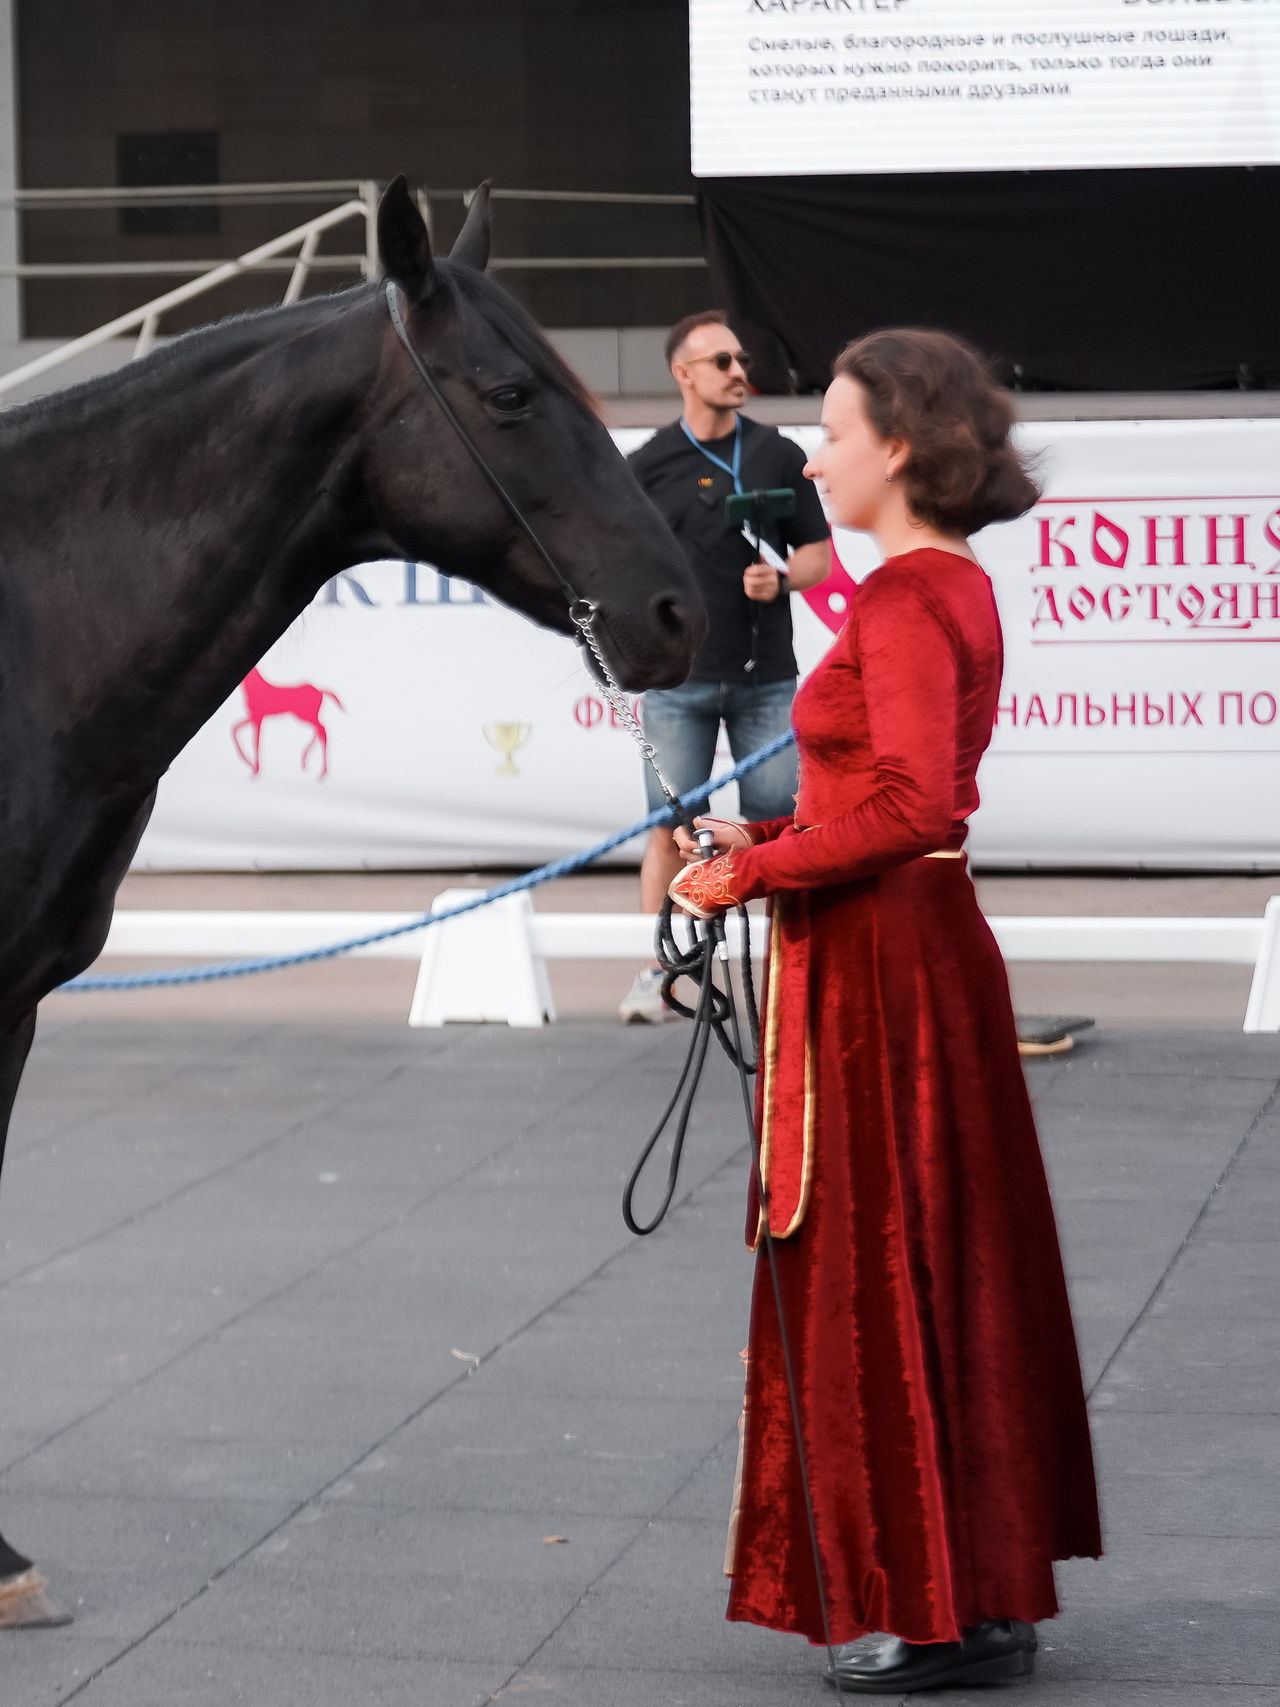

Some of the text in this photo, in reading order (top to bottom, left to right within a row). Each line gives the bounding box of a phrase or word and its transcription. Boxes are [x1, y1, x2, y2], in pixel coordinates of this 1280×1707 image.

[748, 37, 835, 51] Смелые,
[844, 34, 984, 53] благородные
[992, 34, 1003, 45] и
[1011, 31, 1135, 48] послушные
[748, 63, 836, 77] которых
[844, 61, 911, 77] нужно
[1029, 56, 1102, 70] только
[1109, 55, 1166, 70] тогда
[1172, 54, 1212, 66] они
[748, 82, 1070, 102] станут преданными друзьями
[1219, 690, 1278, 726] ПО
